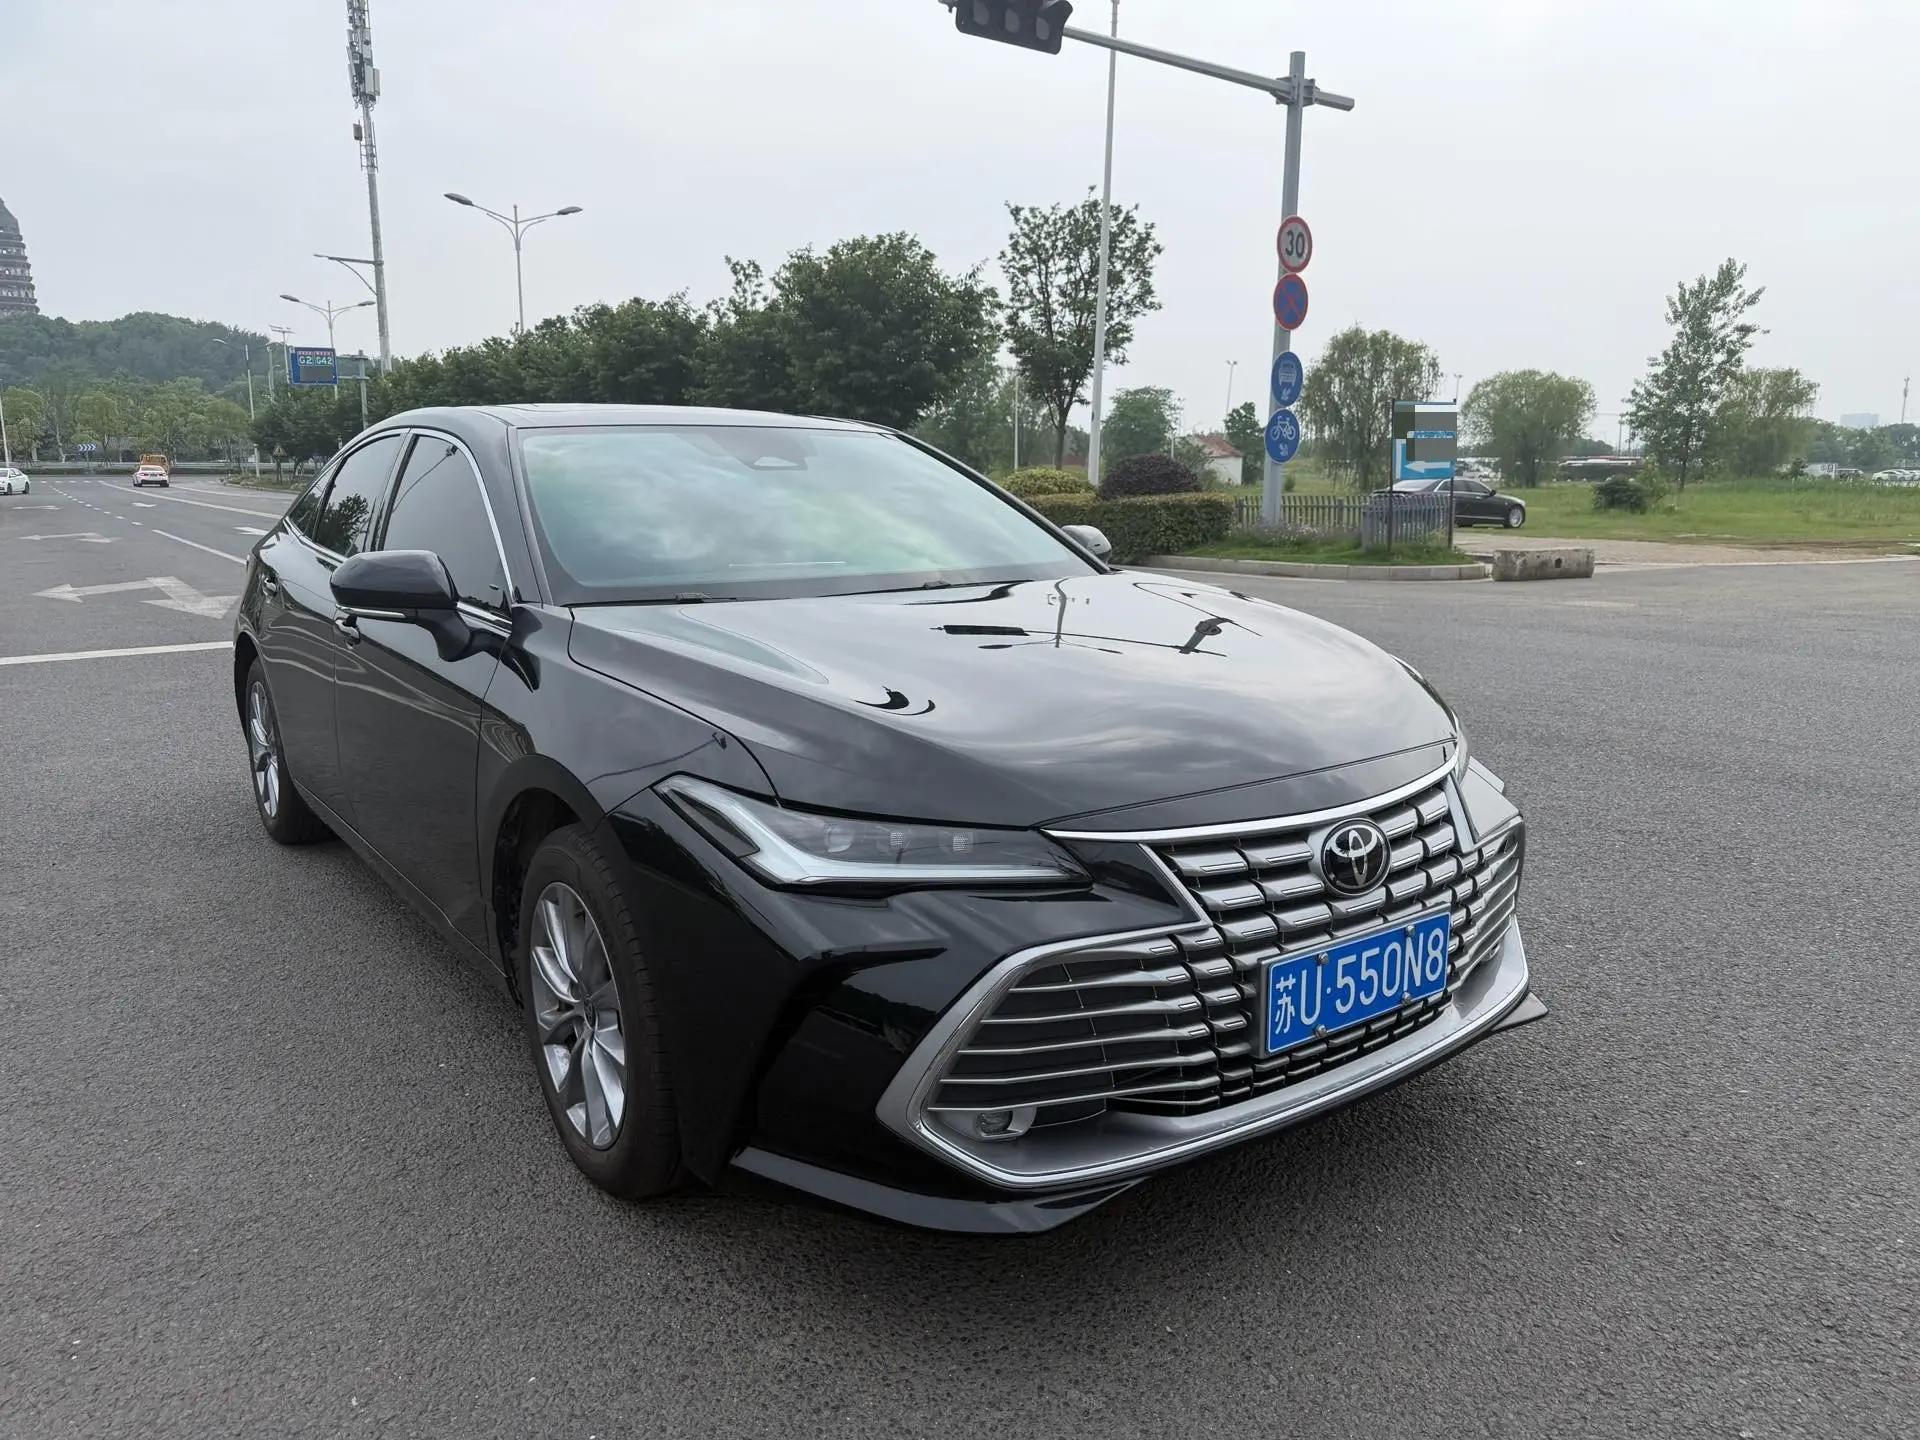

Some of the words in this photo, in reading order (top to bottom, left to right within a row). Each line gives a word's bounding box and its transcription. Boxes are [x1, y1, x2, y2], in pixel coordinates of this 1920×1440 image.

[1285, 230, 1305, 258] 30
[299, 356, 313, 365] G2
[316, 356, 333, 365] G42
[1275, 927, 1444, 1035] 苏U·550N8
